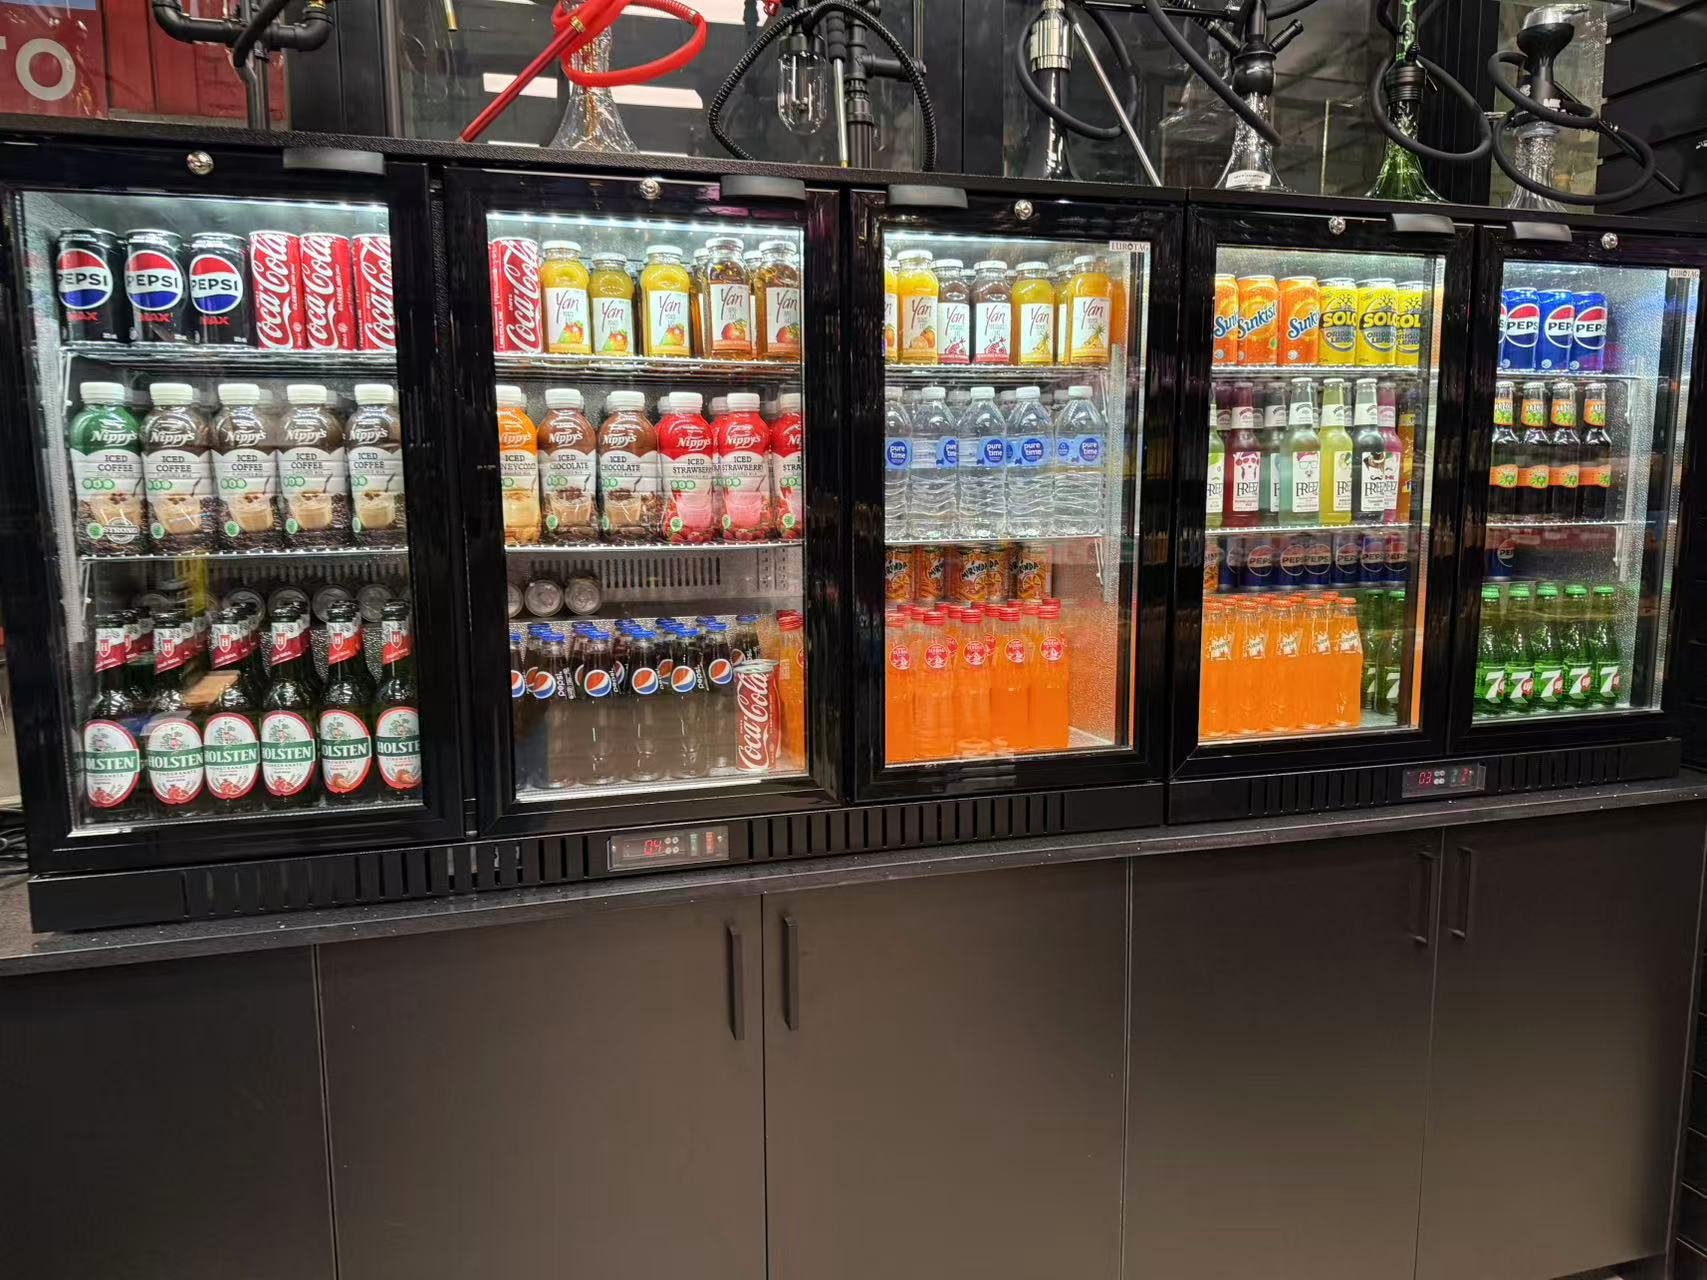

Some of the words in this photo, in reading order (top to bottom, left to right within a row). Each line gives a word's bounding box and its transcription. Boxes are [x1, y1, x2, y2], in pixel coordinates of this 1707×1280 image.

[126, 274, 178, 289] PEPSI
[191, 278, 238, 292] PEPSI
[556, 290, 579, 324] Yan
[659, 293, 681, 326] Yan
[721, 285, 743, 321] Yan
[776, 290, 798, 324] Yan
[602, 300, 624, 332] Yan
[911, 297, 932, 329] Yan
[945, 305, 965, 335] Yan
[985, 305, 1005, 335] Yan
[1030, 305, 1050, 336] Yan
[1081, 298, 1104, 329] Yan
[1507, 321, 1538, 330] PEPS
[1548, 322, 1572, 331] PEP
[1576, 323, 1606, 332] PEPS
[90, 431, 138, 447] Nippy's
[150, 431, 195, 447] Nippy's
[225, 429, 267, 446] Nippy's
[286, 428, 328, 445] Nippy's
[349, 428, 389, 444] Nippy's
[548, 432, 584, 448] Nippy's
[602, 433, 637, 449] Nippy's
[726, 435, 762, 449] Nippy's
[676, 437, 711, 452] Nippy's
[890, 445, 905, 453] pure
[986, 443, 1002, 452] pure
[1024, 442, 1041, 451] pure
[1082, 442, 1097, 450] pure
[1305, 555, 1329, 563] PEPS
[323, 743, 368, 757] OLSTEN
[378, 740, 420, 754] HOLSTE
[149, 754, 203, 768] HOLSTEN
